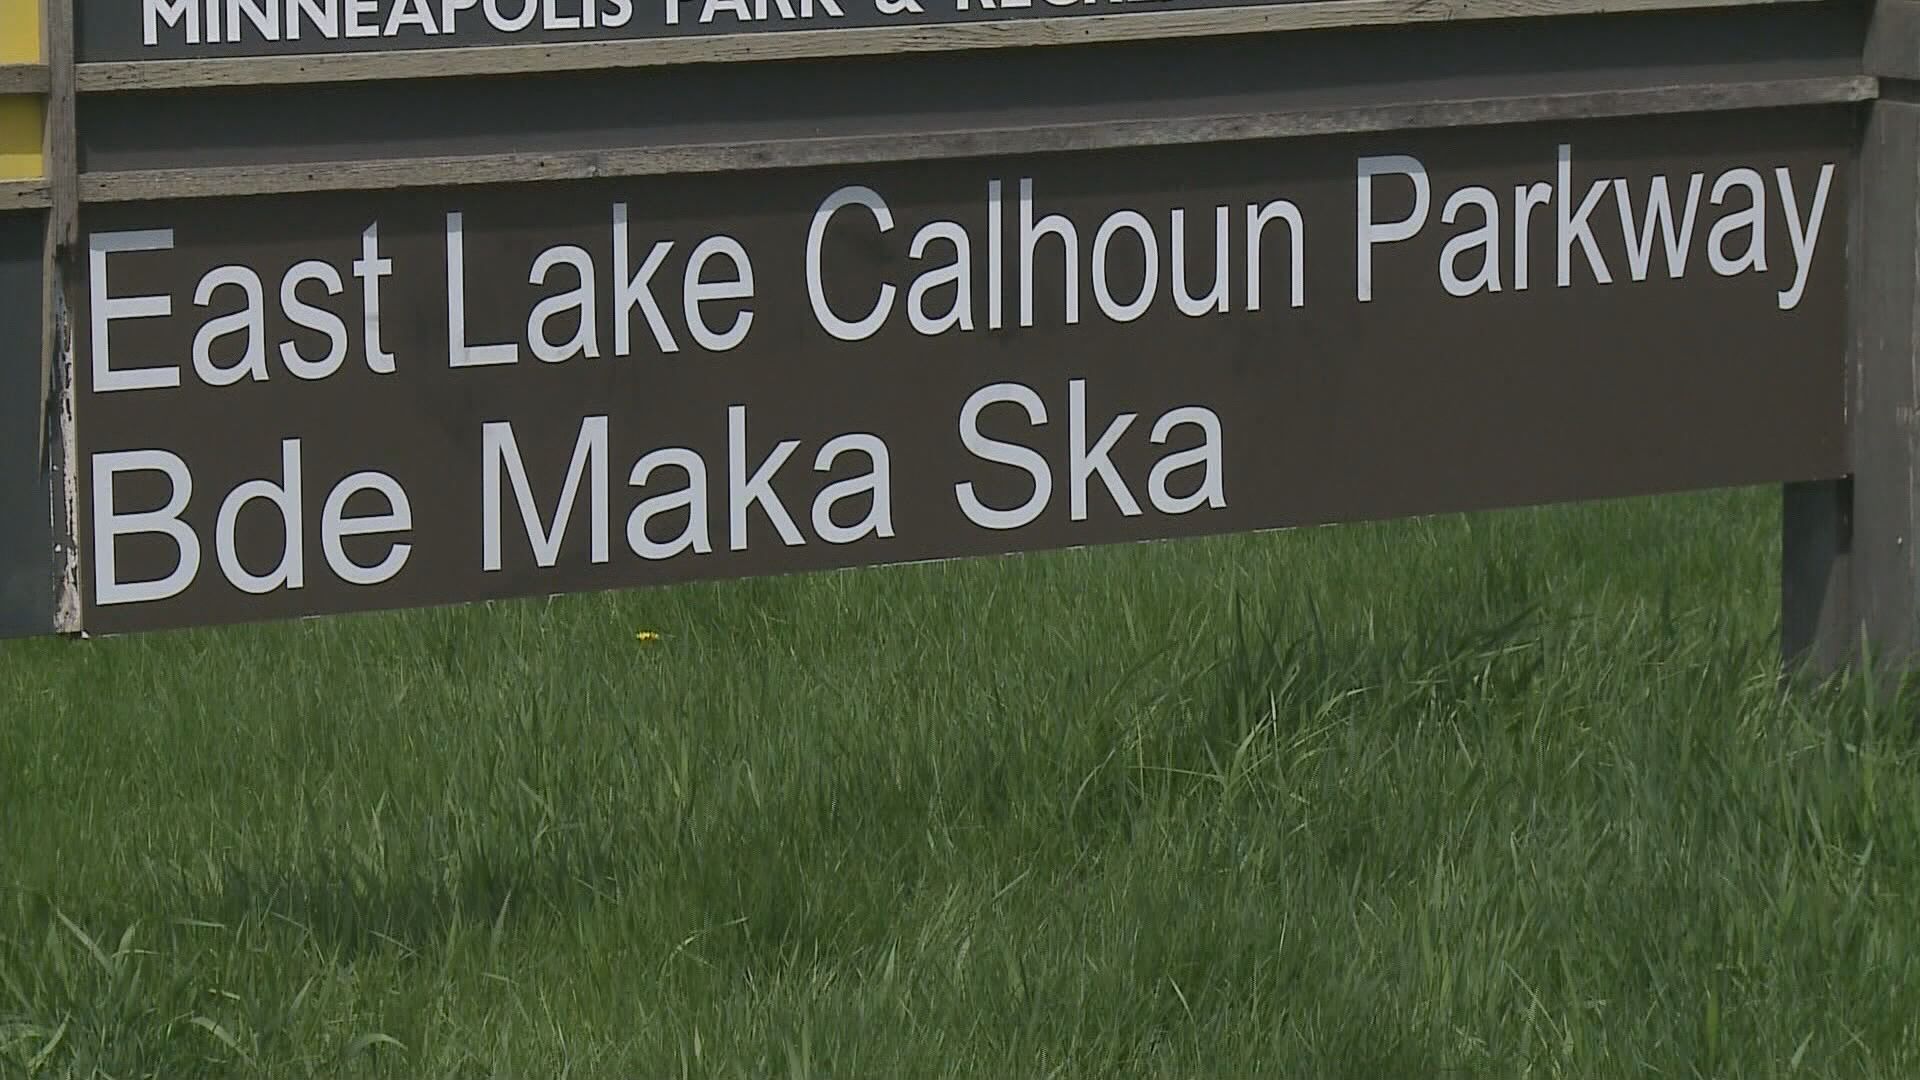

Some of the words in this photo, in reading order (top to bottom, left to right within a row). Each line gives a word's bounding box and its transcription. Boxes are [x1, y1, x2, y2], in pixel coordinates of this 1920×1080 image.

[89, 222, 396, 393] East
[446, 203, 754, 368] Lake
[806, 178, 1304, 341] Calhoun
[1357, 144, 1835, 310] Parkway
[92, 438, 412, 606] Bde
[482, 405, 895, 571] Maka
[955, 379, 1227, 529] Ska
